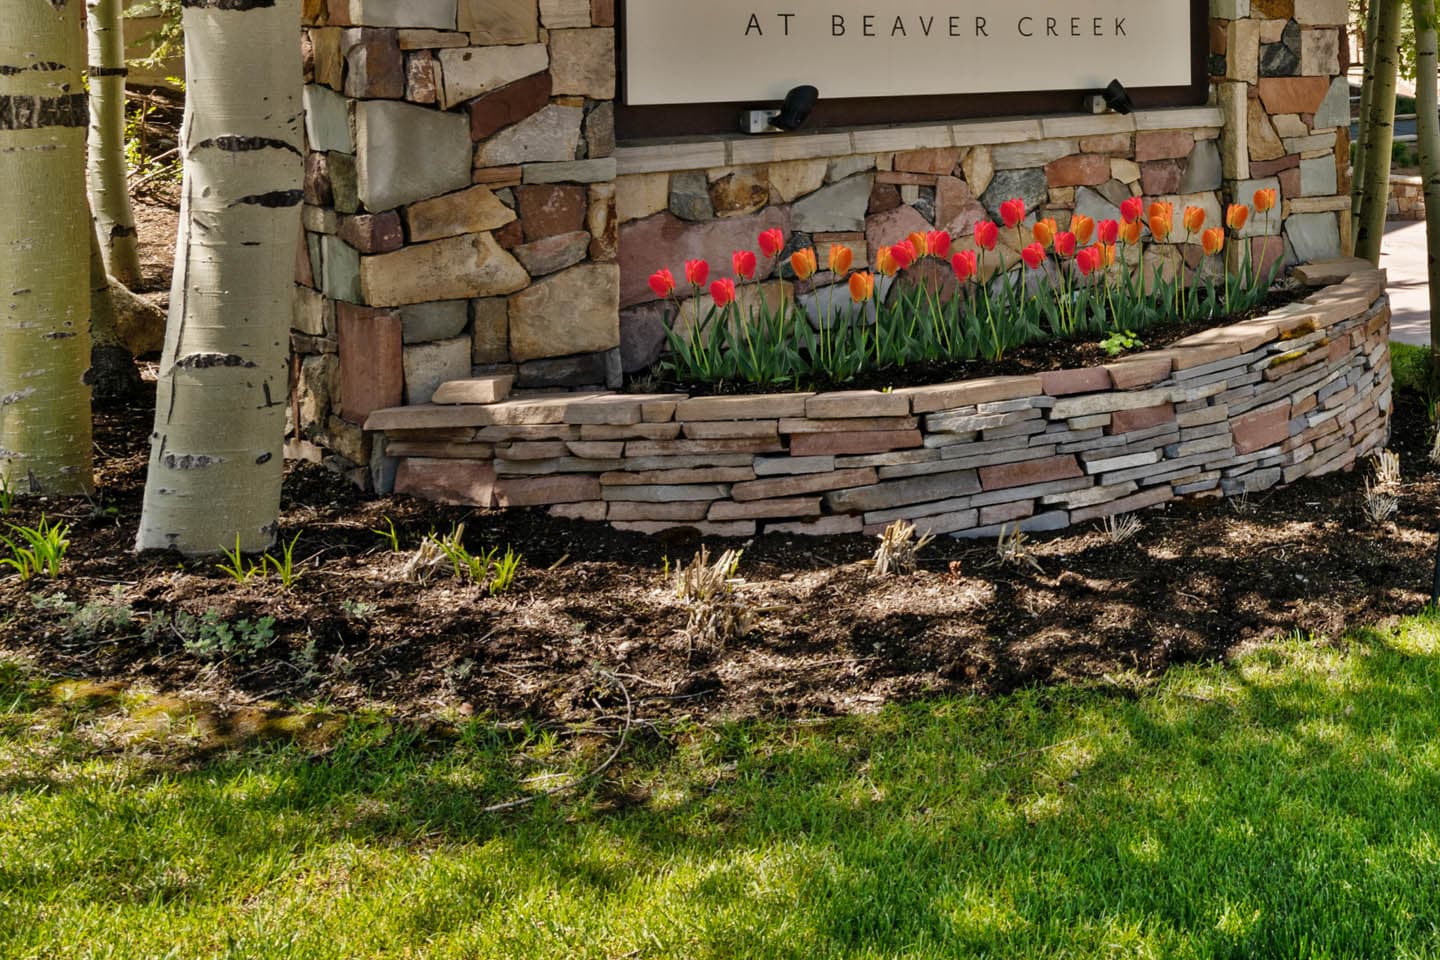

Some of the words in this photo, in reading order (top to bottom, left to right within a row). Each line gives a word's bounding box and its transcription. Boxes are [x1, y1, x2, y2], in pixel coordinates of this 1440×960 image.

[744, 13, 795, 36] AT
[831, 14, 989, 37] BEAVER
[1017, 16, 1127, 37] CREEK
